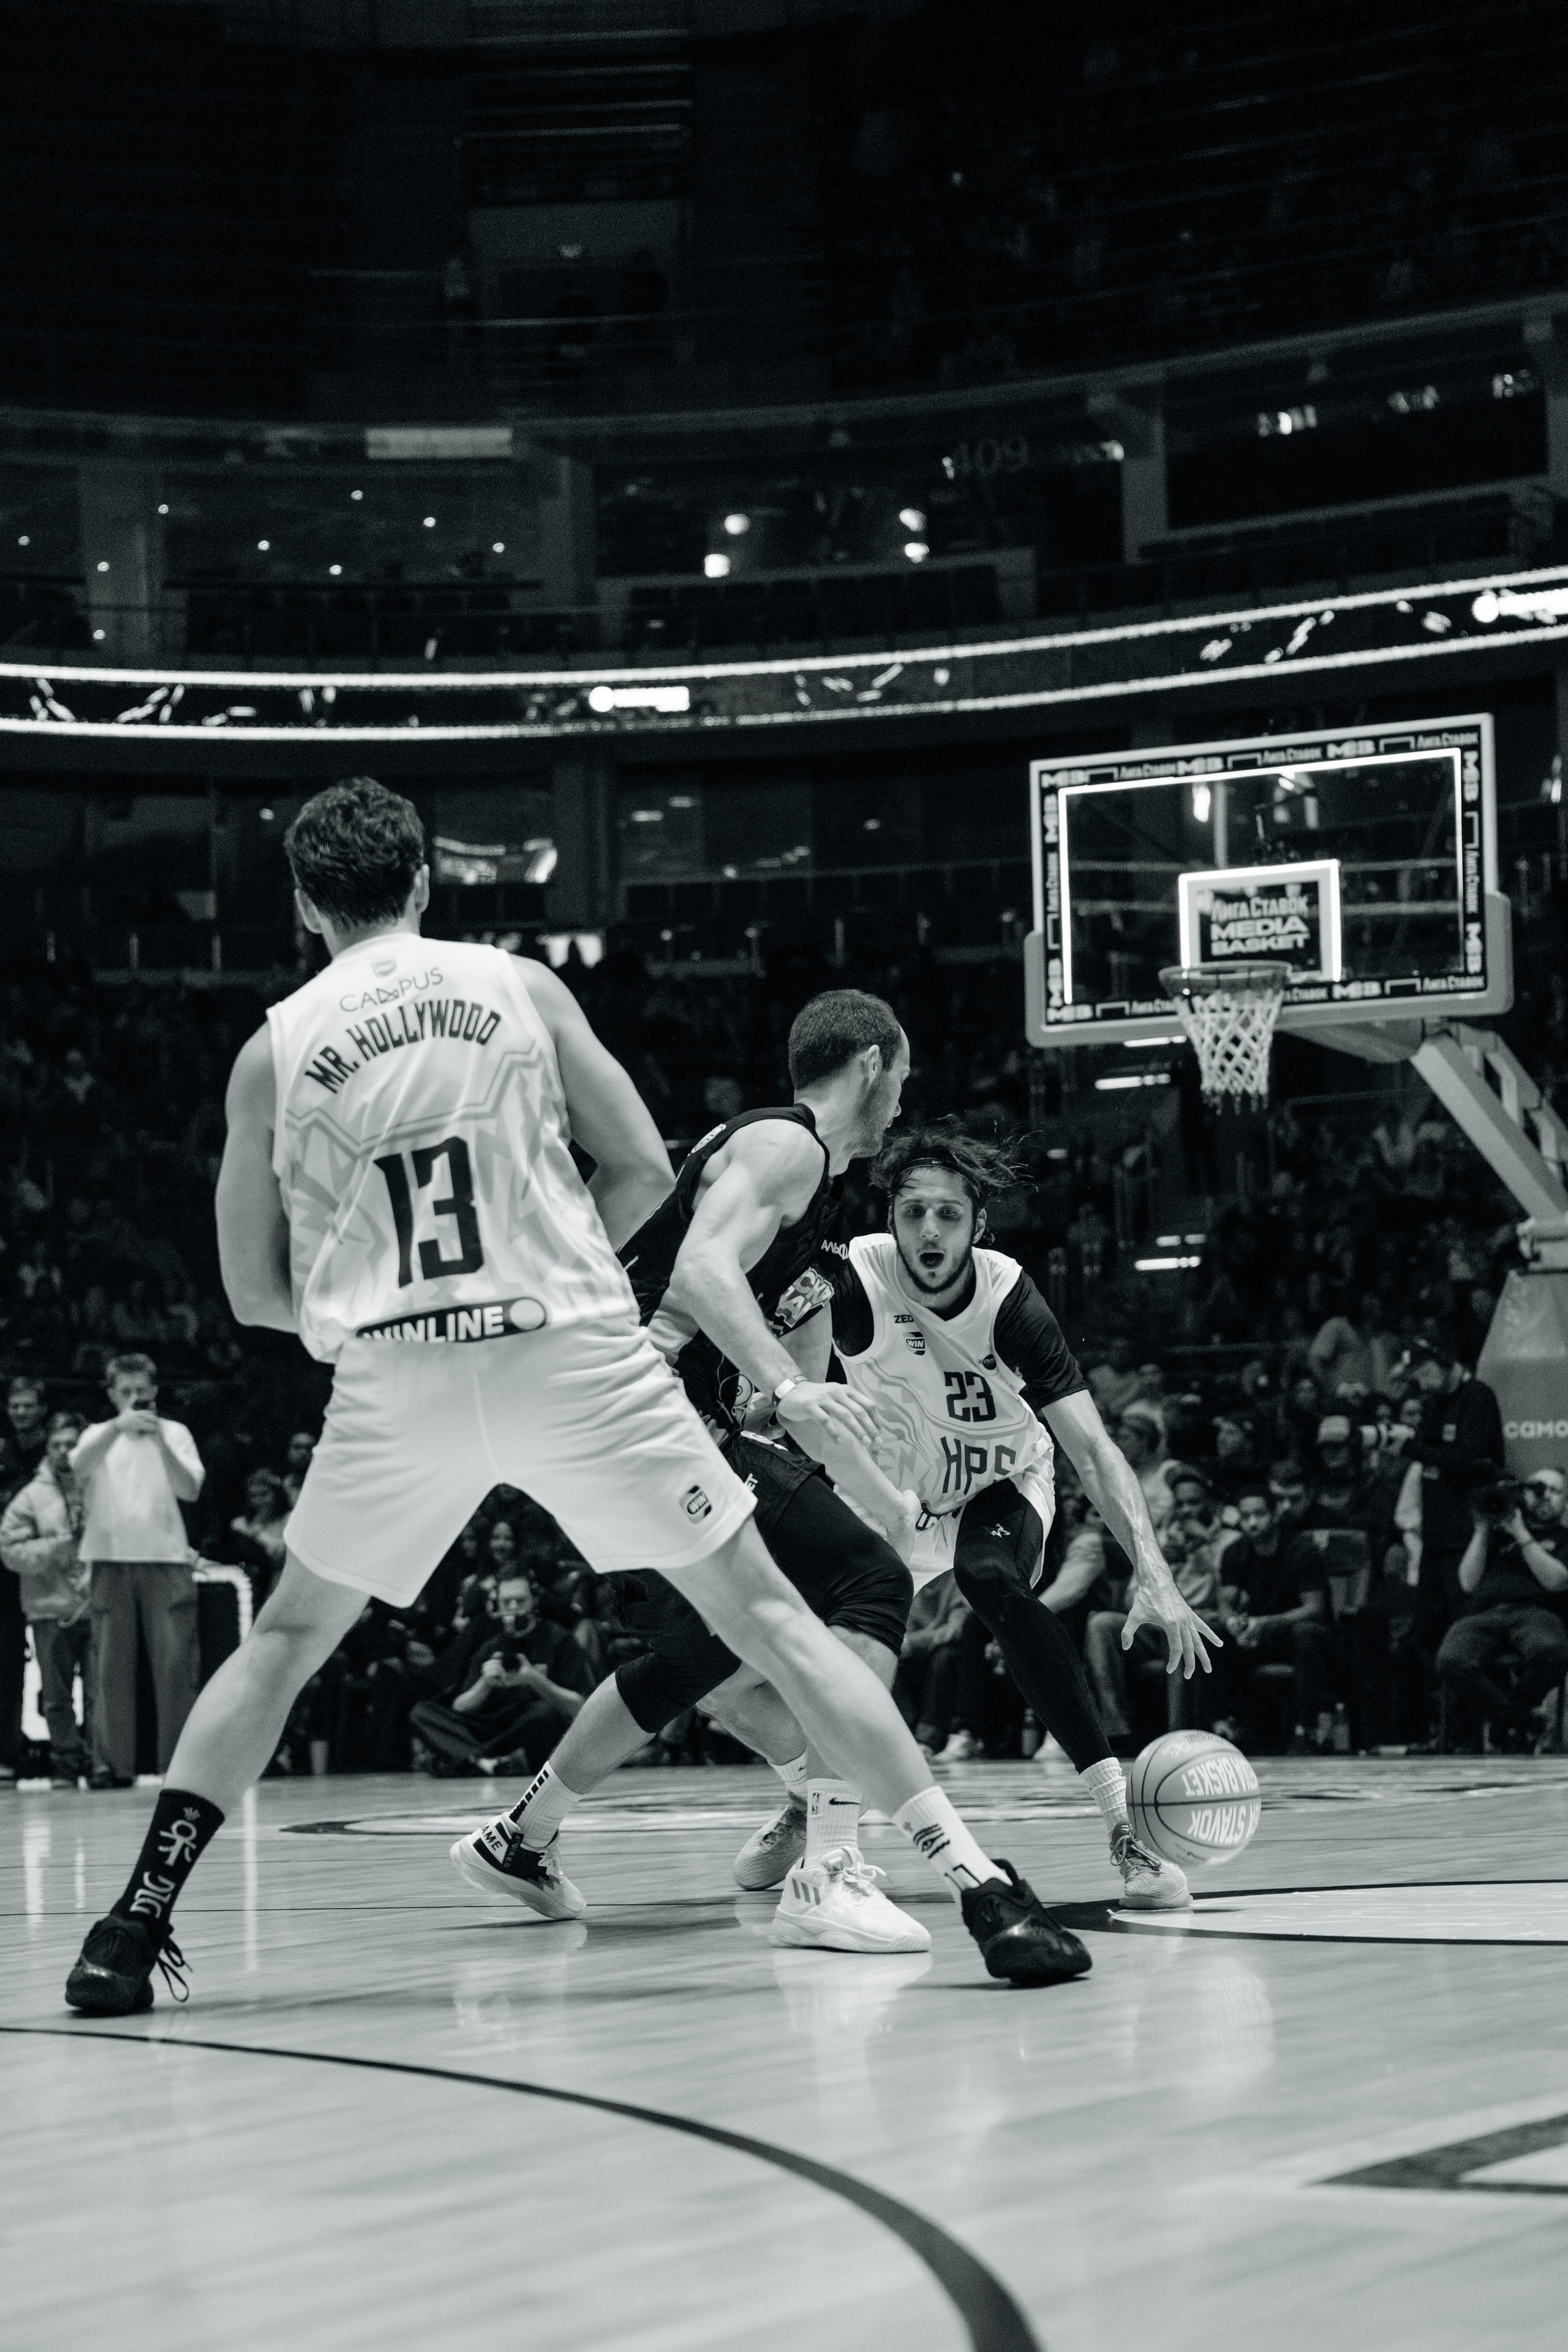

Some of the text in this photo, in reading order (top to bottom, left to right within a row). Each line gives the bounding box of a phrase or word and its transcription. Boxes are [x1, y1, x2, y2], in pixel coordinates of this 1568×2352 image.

[1211, 916, 1310, 941] MEDIA
[1211, 932, 1311, 956] BASKET
[305, 998, 502, 1095] MR. HOLLYWOOD
[373, 1136, 485, 1289] 13
[907, 1338, 925, 1349] WIN
[943, 1371, 997, 1423] 23
[1182, 1757, 1240, 1796] BASKET
[480, 1822, 503, 1852] AME
[1186, 1804, 1246, 1844] STAVOK
